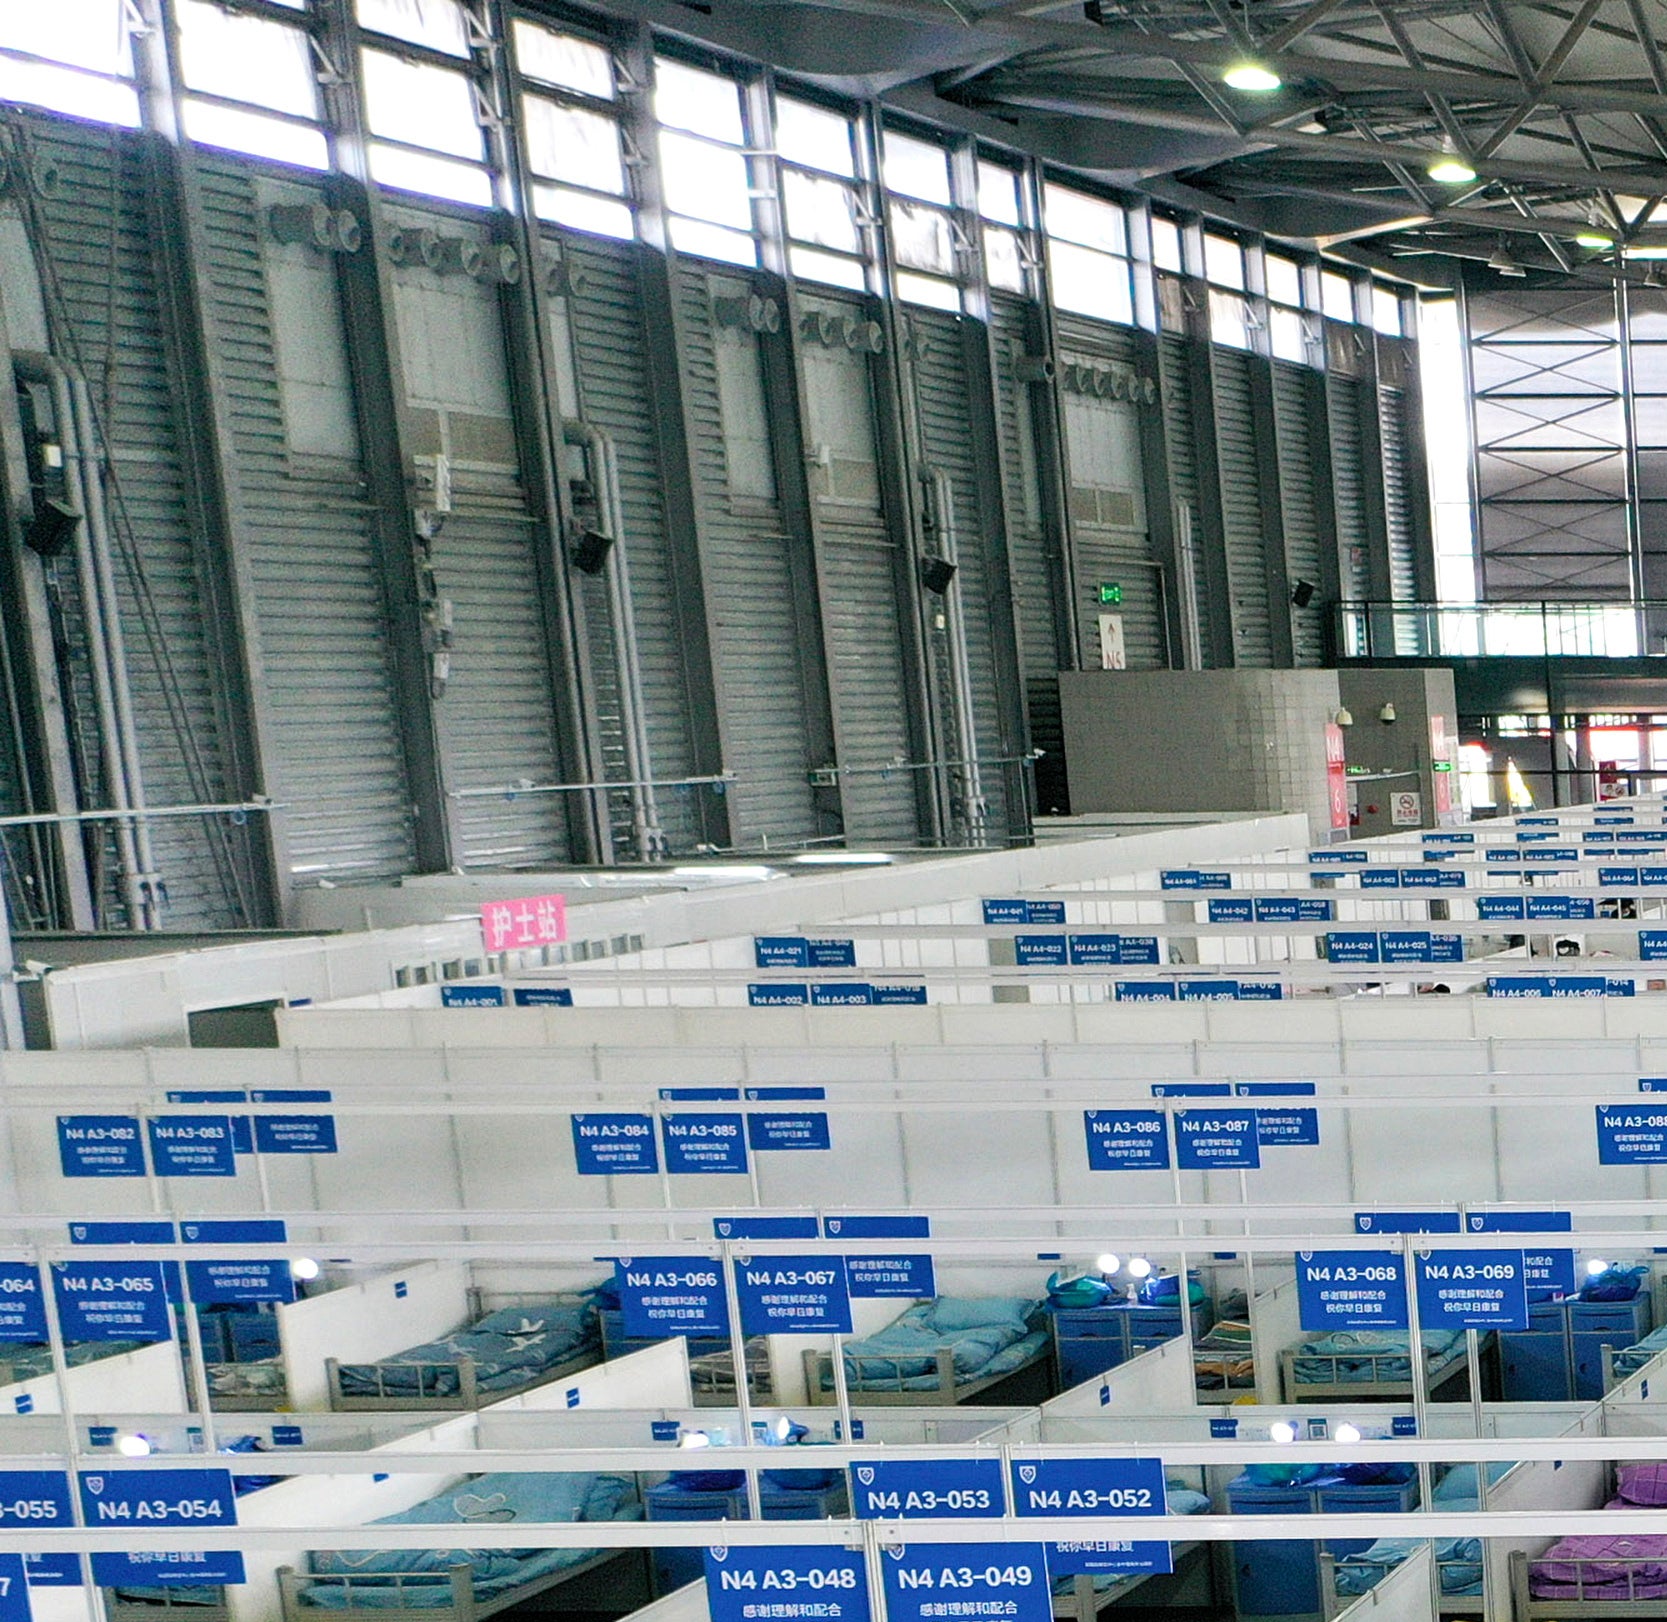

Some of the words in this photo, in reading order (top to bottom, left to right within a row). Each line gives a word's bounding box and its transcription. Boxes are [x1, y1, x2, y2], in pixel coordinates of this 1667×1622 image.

[493, 899, 557, 947] 护士站
[627, 1273, 651, 1286] N4
[655, 1273, 717, 1286] A3-066
[747, 1272, 771, 1285] N4
[775, 1271, 835, 1284] A3-067
[1307, 1268, 1330, 1281] N4
[1334, 1267, 1396, 1280] A3-068
[1426, 1266, 1449, 1279] N4
[1453, 1265, 1514, 1279] A3-069
[63, 1278, 87, 1291] N4
[92, 1278, 154, 1291] A3-065
[868, 1492, 900, 1509] N4
[906, 1490, 989, 1509] A3-053
[1030, 1491, 1062, 1508] N4
[1067, 1489, 1151, 1508] A3-052
[98, 1502, 131, 1519] N4
[136, 1500, 222, 1518] A3-054
[721, 1570, 757, 1589] N4
[763, 1569, 856, 1589] A3-048
[899, 1569, 934, 1588] N4
[940, 1566, 1031, 1587] A3-049
[743, 1603, 841, 1618] 感谢理解和配合
[920, 1601, 1017, 1616] 感谢理解和配合
